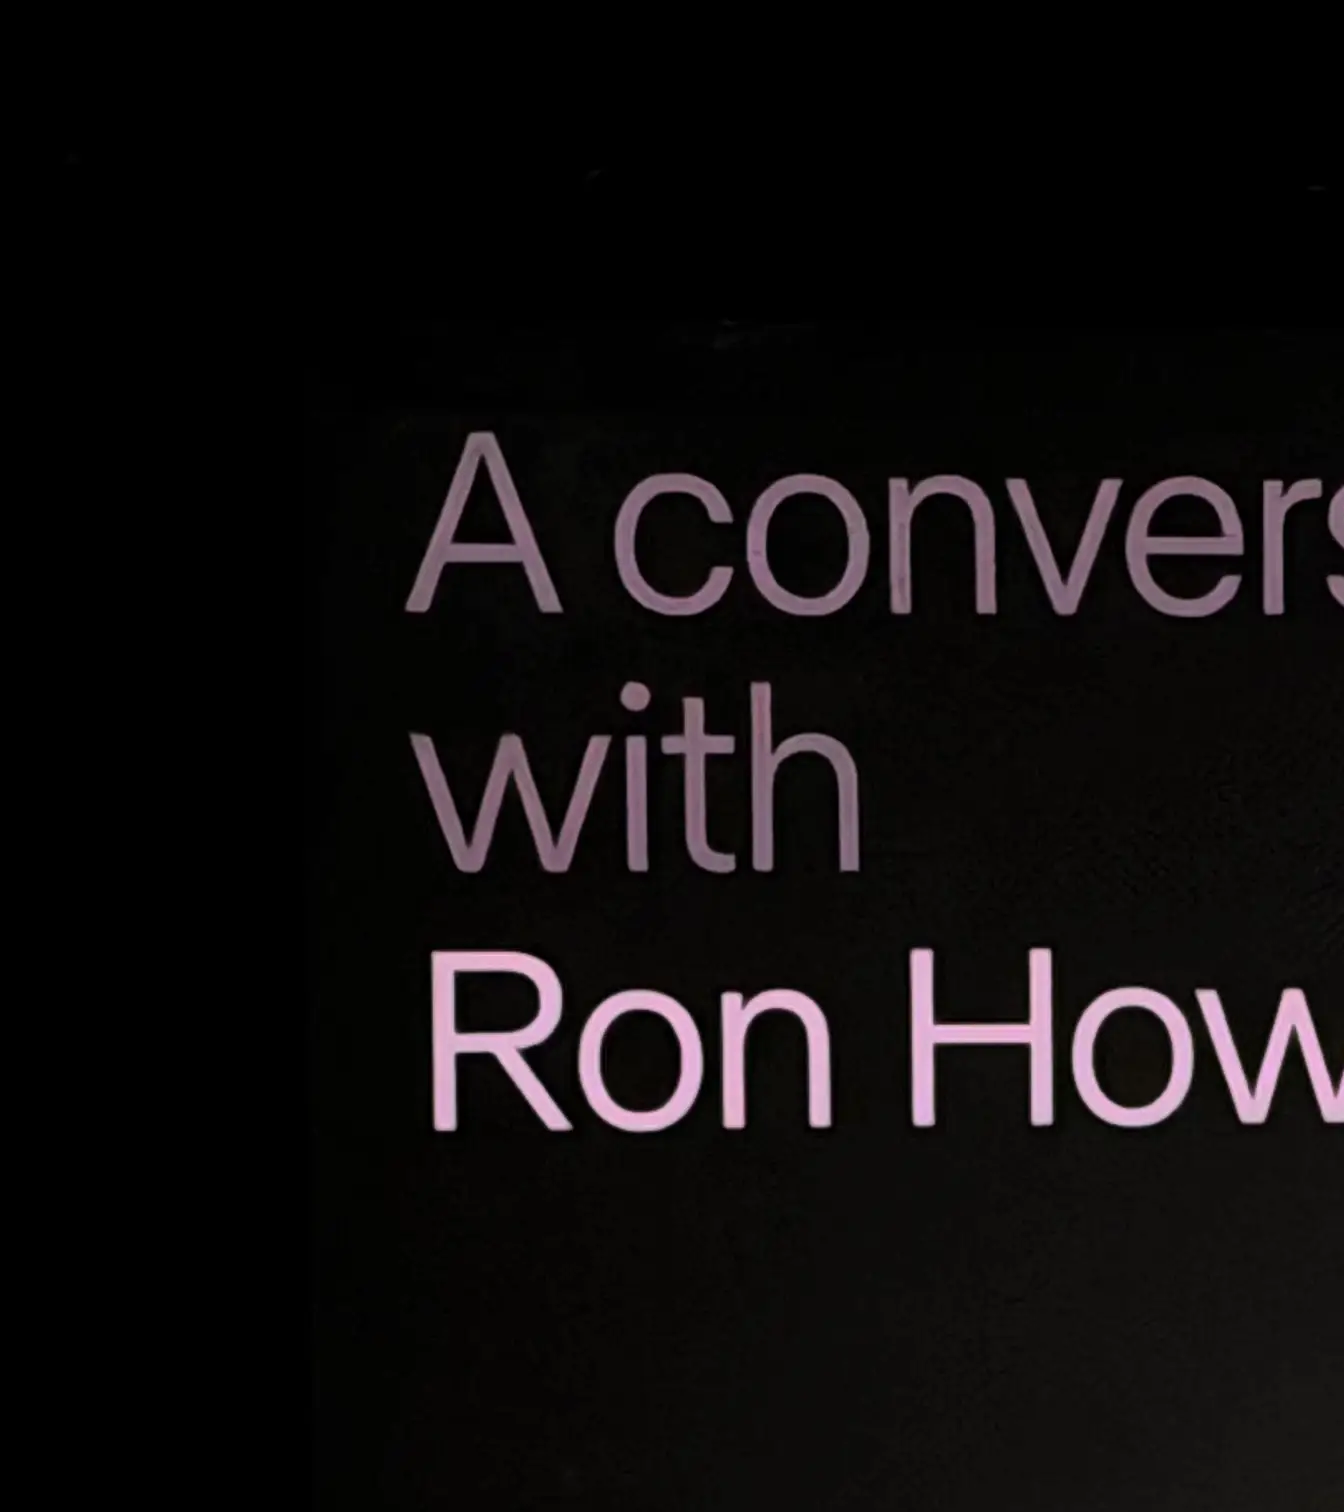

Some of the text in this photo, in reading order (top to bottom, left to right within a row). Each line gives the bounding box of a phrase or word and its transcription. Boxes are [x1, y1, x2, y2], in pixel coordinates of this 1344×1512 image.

[406, 432, 562, 612] A
[411, 681, 860, 873] with
[430, 949, 833, 1133] Ron
